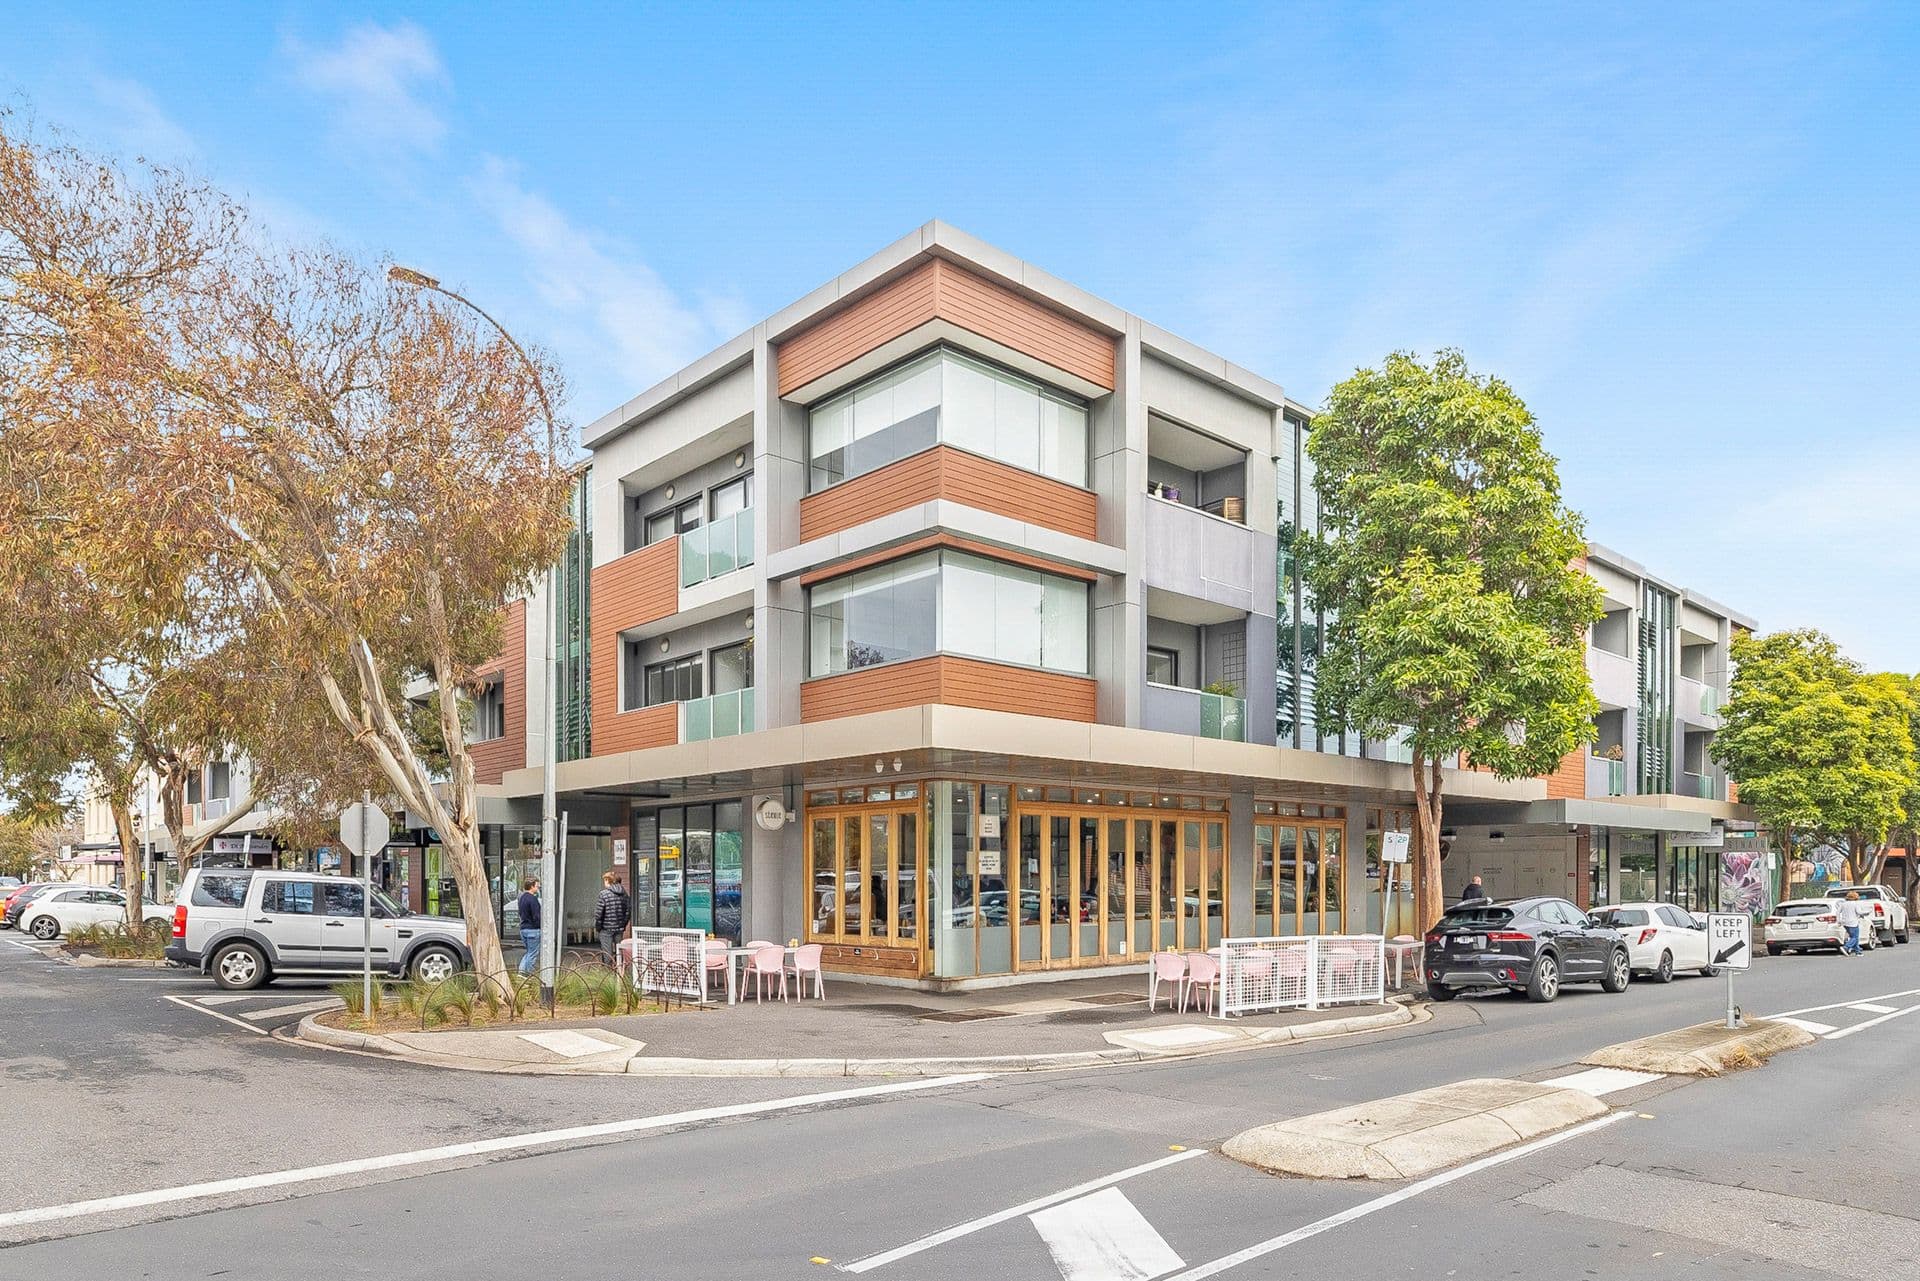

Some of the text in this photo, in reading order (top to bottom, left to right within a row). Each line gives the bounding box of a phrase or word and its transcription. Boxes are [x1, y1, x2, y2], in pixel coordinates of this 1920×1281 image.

[1397, 836, 1408, 844] 2P
[1715, 918, 1742, 927] KEEP
[1716, 929, 1741, 938] LEFT
